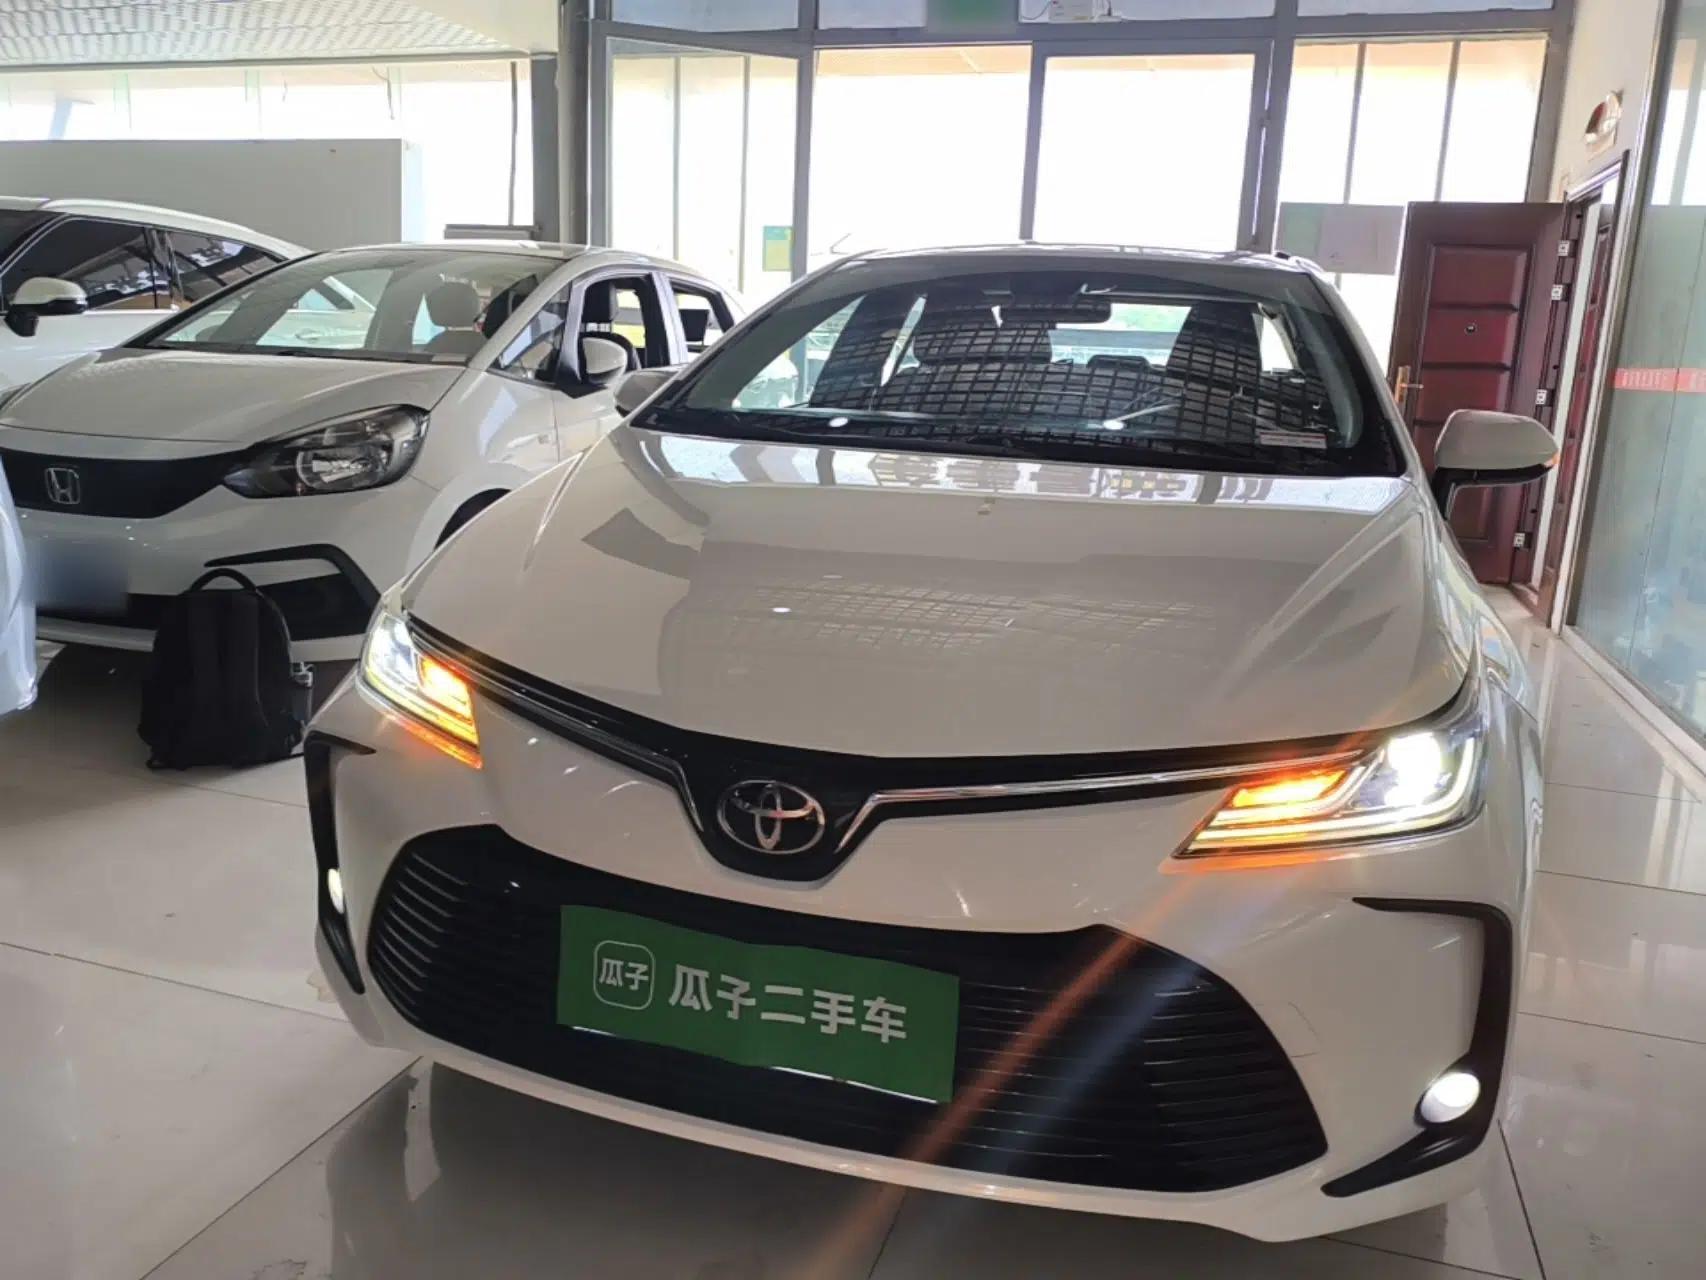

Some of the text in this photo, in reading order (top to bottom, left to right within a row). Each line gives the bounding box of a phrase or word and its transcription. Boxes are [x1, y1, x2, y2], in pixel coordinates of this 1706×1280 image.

[599, 957, 650, 991] 瓜子
[668, 963, 907, 1043] 瓜子二手车
